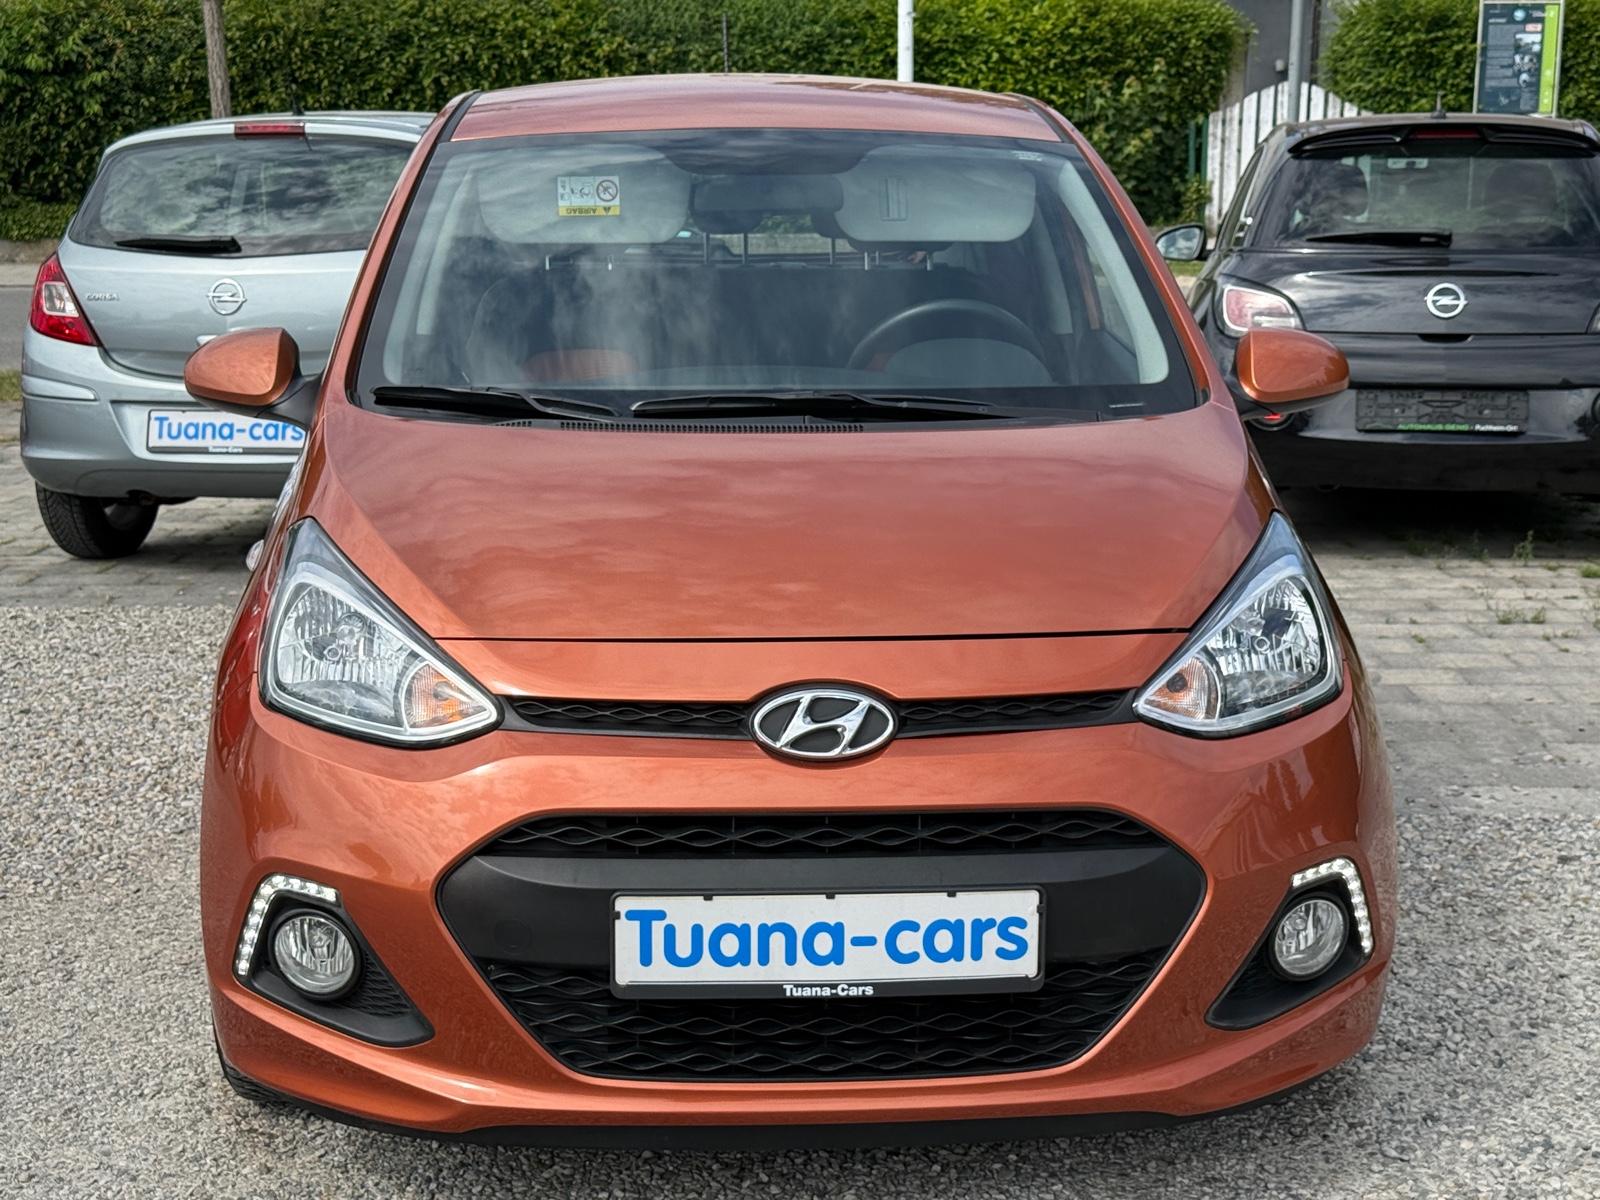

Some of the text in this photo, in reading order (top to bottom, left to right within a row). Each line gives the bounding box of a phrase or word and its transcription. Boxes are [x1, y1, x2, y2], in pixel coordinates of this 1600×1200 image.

[154, 416, 304, 441] Tuana-cars
[625, 909, 1029, 968] Tuana-cars
[783, 984, 874, 997] Tuana-Cars
